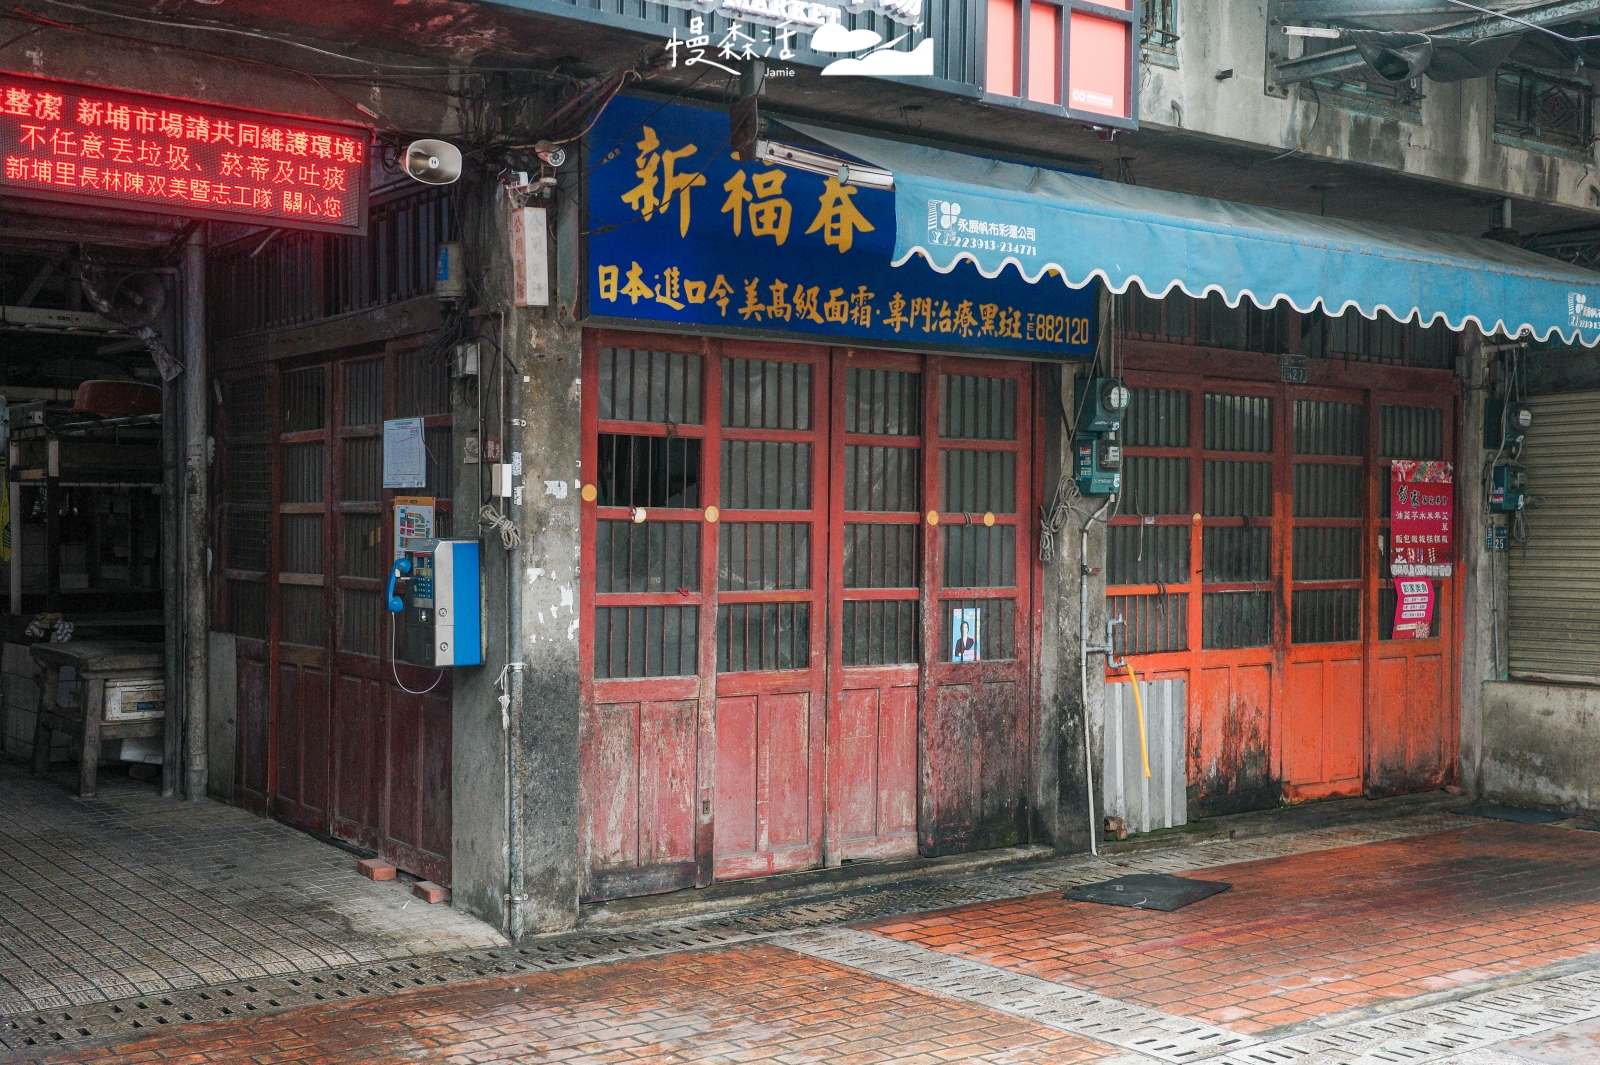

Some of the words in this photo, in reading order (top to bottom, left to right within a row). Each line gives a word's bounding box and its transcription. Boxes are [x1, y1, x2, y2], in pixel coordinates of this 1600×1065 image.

[0, 87, 63, 121] 整潔
[282, 190, 342, 218] 關心您
[621, 125, 875, 254] 新福春
[1026, 313, 1035, 341] TEL
[1036, 313, 1089, 345] 882120
[1494, 538, 1504, 549] 25
